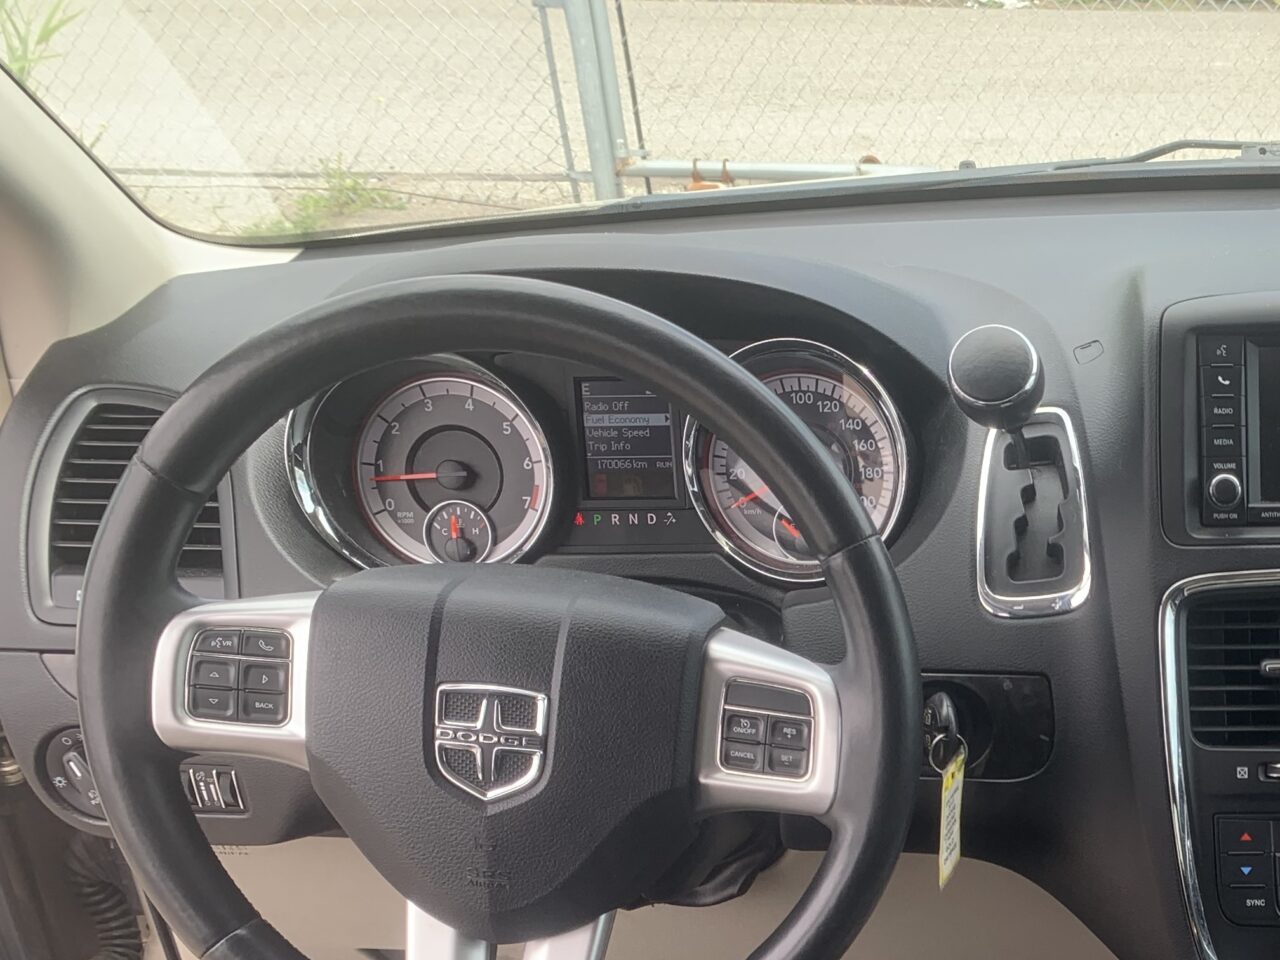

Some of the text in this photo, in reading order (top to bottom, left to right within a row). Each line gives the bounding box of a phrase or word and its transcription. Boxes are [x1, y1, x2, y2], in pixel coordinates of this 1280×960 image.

[790, 393, 814, 404] 100
[424, 400, 433, 411] 3
[465, 400, 474, 411] 4
[584, 401, 630, 411] Radio Off
[817, 401, 840, 412] 120
[585, 415, 650, 426] Fuel Economy
[840, 419, 862, 430] 140
[391, 422, 400, 434] 2
[502, 422, 511, 434] 5
[586, 428, 650, 438] Vehicle Speed
[587, 441, 631, 451] Trip Info
[852, 440, 875, 451] 160
[376, 460, 384, 472] 1
[523, 458, 532, 470] 6
[729, 469, 746, 480] 20
[859, 468, 882, 479] 180
[385, 499, 395, 510] 0
[522, 497, 531, 509] 7
[593, 514, 657, 525] P R N D
[472, 527, 479, 535] H
[733, 726, 757, 735] ON/OFF
[783, 727, 797, 735] RES
[435, 728, 541, 747] DODGE
[730, 750, 755, 760] CANCEL
[781, 754, 793, 762] SET
